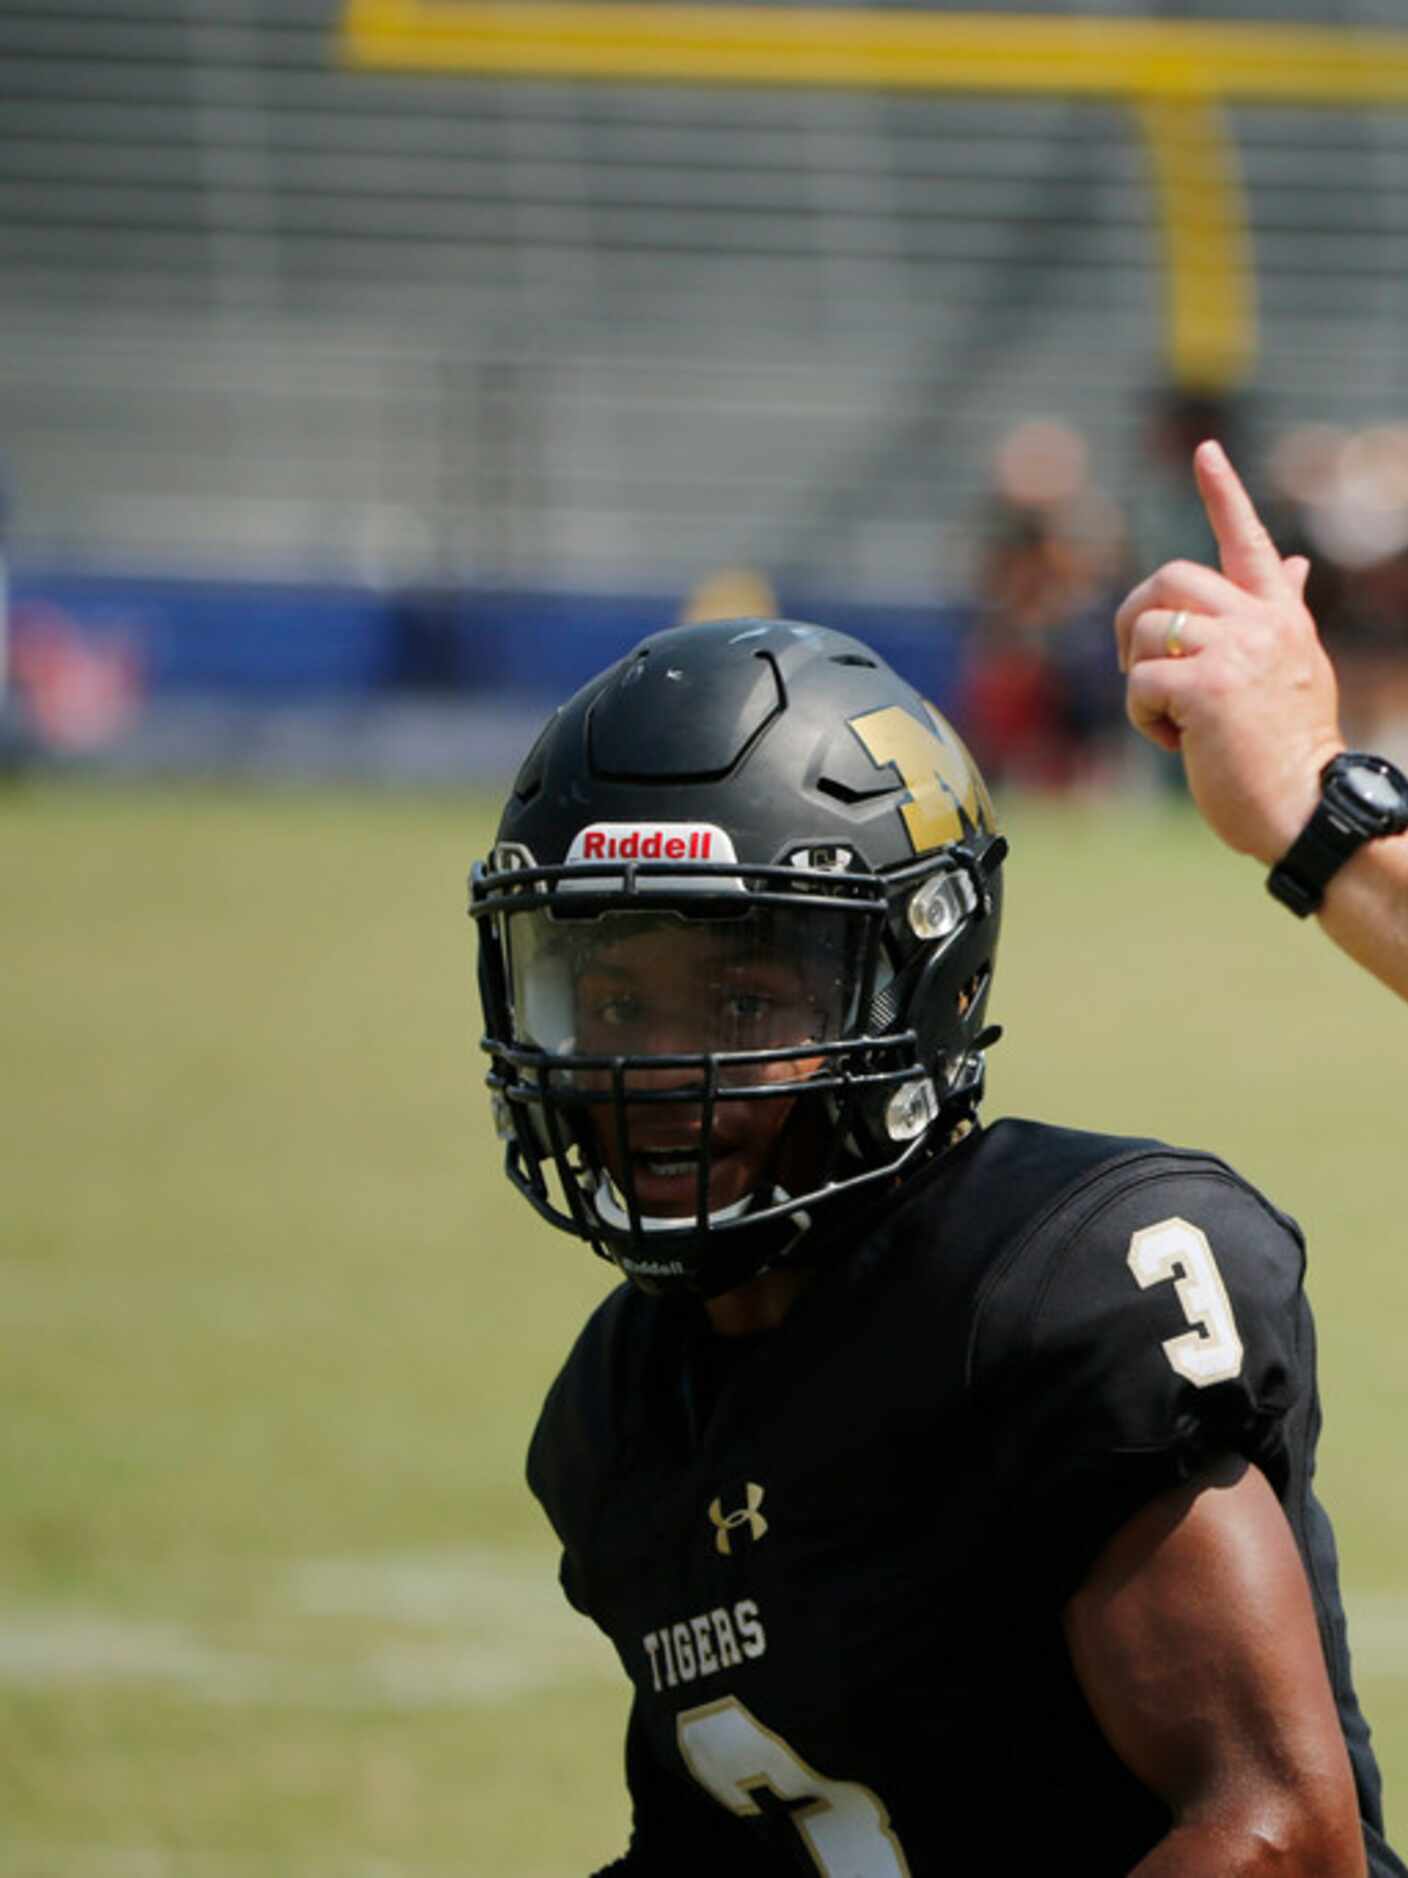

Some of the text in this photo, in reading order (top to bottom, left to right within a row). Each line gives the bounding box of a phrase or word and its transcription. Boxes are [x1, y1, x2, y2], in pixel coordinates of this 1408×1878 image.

[583, 831, 712, 860] Riddell
[1127, 1216, 1244, 1389] 3
[643, 1599, 767, 1692] TIGERS
